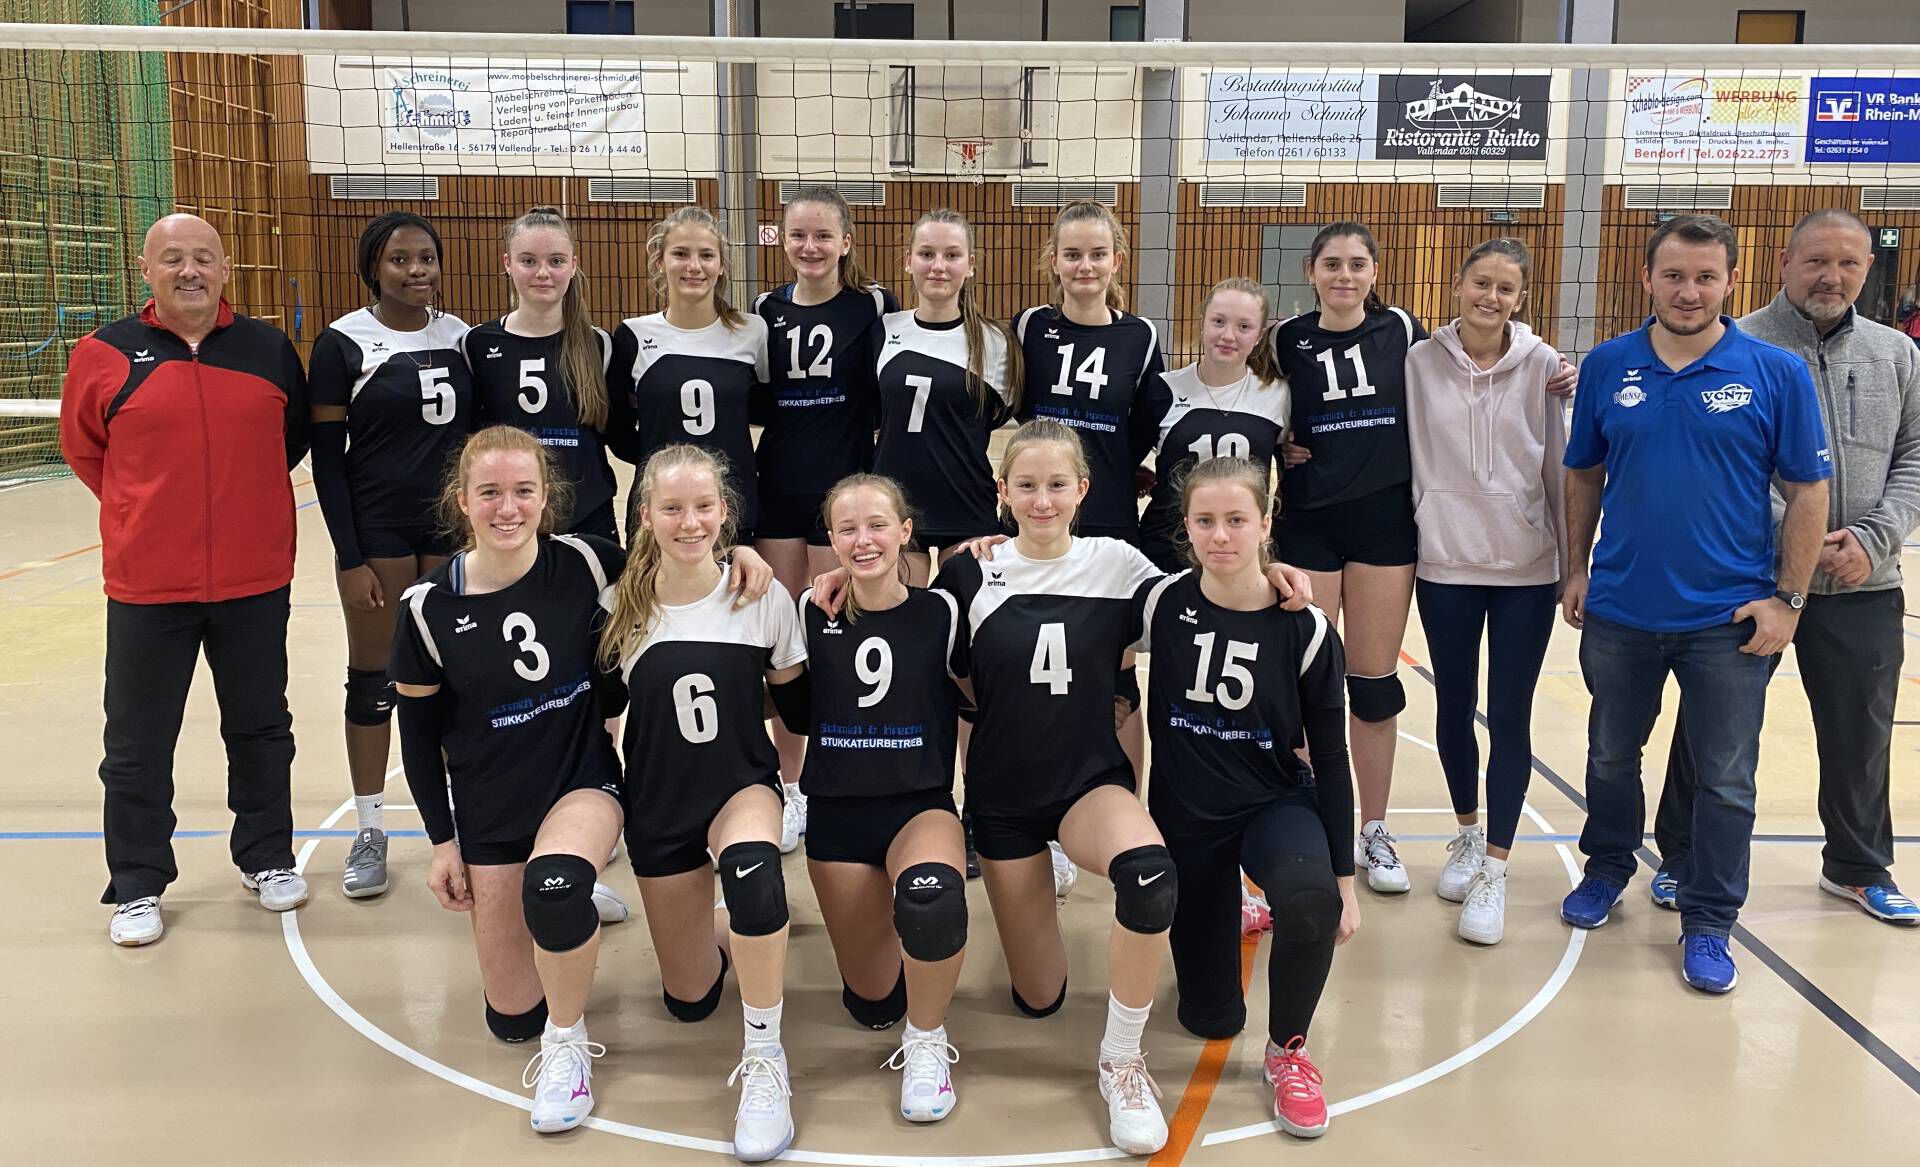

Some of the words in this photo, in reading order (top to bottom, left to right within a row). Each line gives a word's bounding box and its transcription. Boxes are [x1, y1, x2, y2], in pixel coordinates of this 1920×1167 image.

[402, 71, 472, 92] Schreinerei
[489, 73, 640, 83] www.moebelschreinerei-schmidt.de
[1220, 75, 1365, 97] Bestattungsinstitut
[497, 104, 546, 117] Verlegung
[548, 100, 567, 109] von
[569, 91, 633, 106] Parkettböden
[1716, 90, 1798, 103] WERBUNG
[1866, 93, 1885, 104] VR
[1889, 92, 1920, 105] Bank
[546, 110, 575, 121] feiner
[577, 102, 640, 117] Innenausbau
[1215, 102, 1291, 124] Johannes
[1301, 103, 1368, 121] Schmidt
[501, 121, 587, 139] Reparaturarbeiten
[1219, 133, 1273, 144] Vallendar,
[1277, 133, 1346, 144] Hellenstraße
[1384, 128, 1481, 147] Ristorante
[1485, 128, 1541, 148] Rialto
[1635, 129, 1684, 137] Lichtwerbung
[390, 142, 446, 152] Hellenstraße
[468, 143, 496, 152] 56179
[499, 144, 542, 153] Vallendar
[549, 144, 568, 153] Tel.:
[1234, 147, 1275, 158] Telefon
[1278, 147, 1303, 158] 0261
[1313, 147, 1346, 158] 60133
[1417, 146, 1458, 156] Vallendar
[1459, 147, 1479, 156] 0261
[1480, 147, 1506, 156] 60329
[1634, 148, 1685, 158] Bendorf
[1694, 148, 1715, 159] Tel.
[1716, 149, 1790, 159] 02622.2773
[134, 355, 155, 364] erima
[785, 323, 834, 380] 12
[1050, 342, 1109, 400] 14
[1316, 343, 1376, 402] 11
[517, 356, 549, 414] 5
[417, 366, 457, 426] 5
[904, 373, 933, 433] 7
[1703, 391, 1752, 401] VCN77
[679, 378, 716, 437] 9
[454, 621, 478, 634] erima
[1178, 614, 1199, 625] erima
[501, 610, 551, 682] 3
[1029, 622, 1073, 696] 4
[854, 636, 894, 708] 9
[1185, 631, 1260, 711] 15
[671, 672, 719, 744] 6
